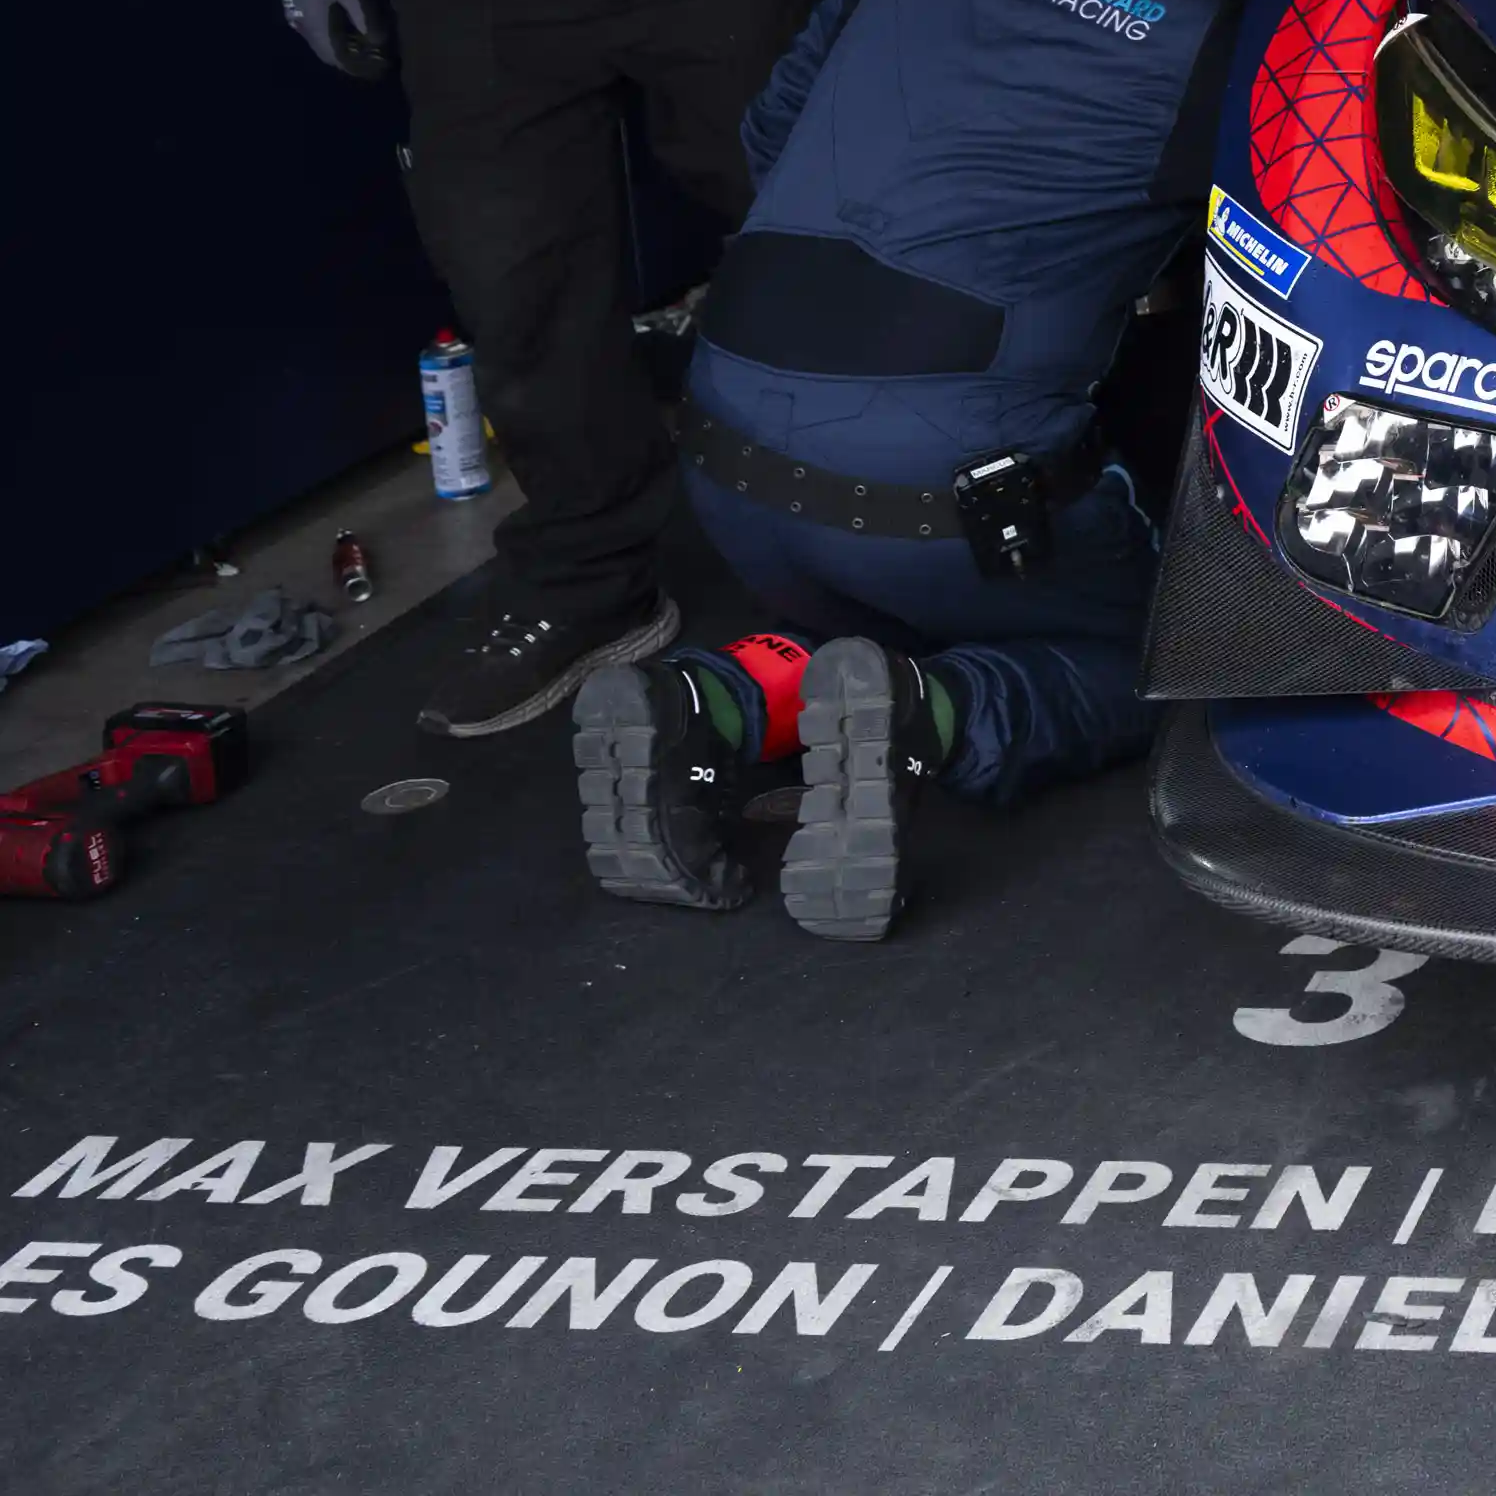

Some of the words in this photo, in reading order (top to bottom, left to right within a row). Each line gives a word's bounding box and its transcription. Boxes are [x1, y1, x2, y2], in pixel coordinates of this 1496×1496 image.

[1226, 220, 1290, 277] MICHELIN
[1283, 352, 1309, 433] www.h-r.com
[1232, 936, 1430, 1048] 3
[11, 1135, 393, 1208] MAX
[403, 1146, 1373, 1233] VERSTAPPEN
[193, 1248, 880, 1337] GOUNON
